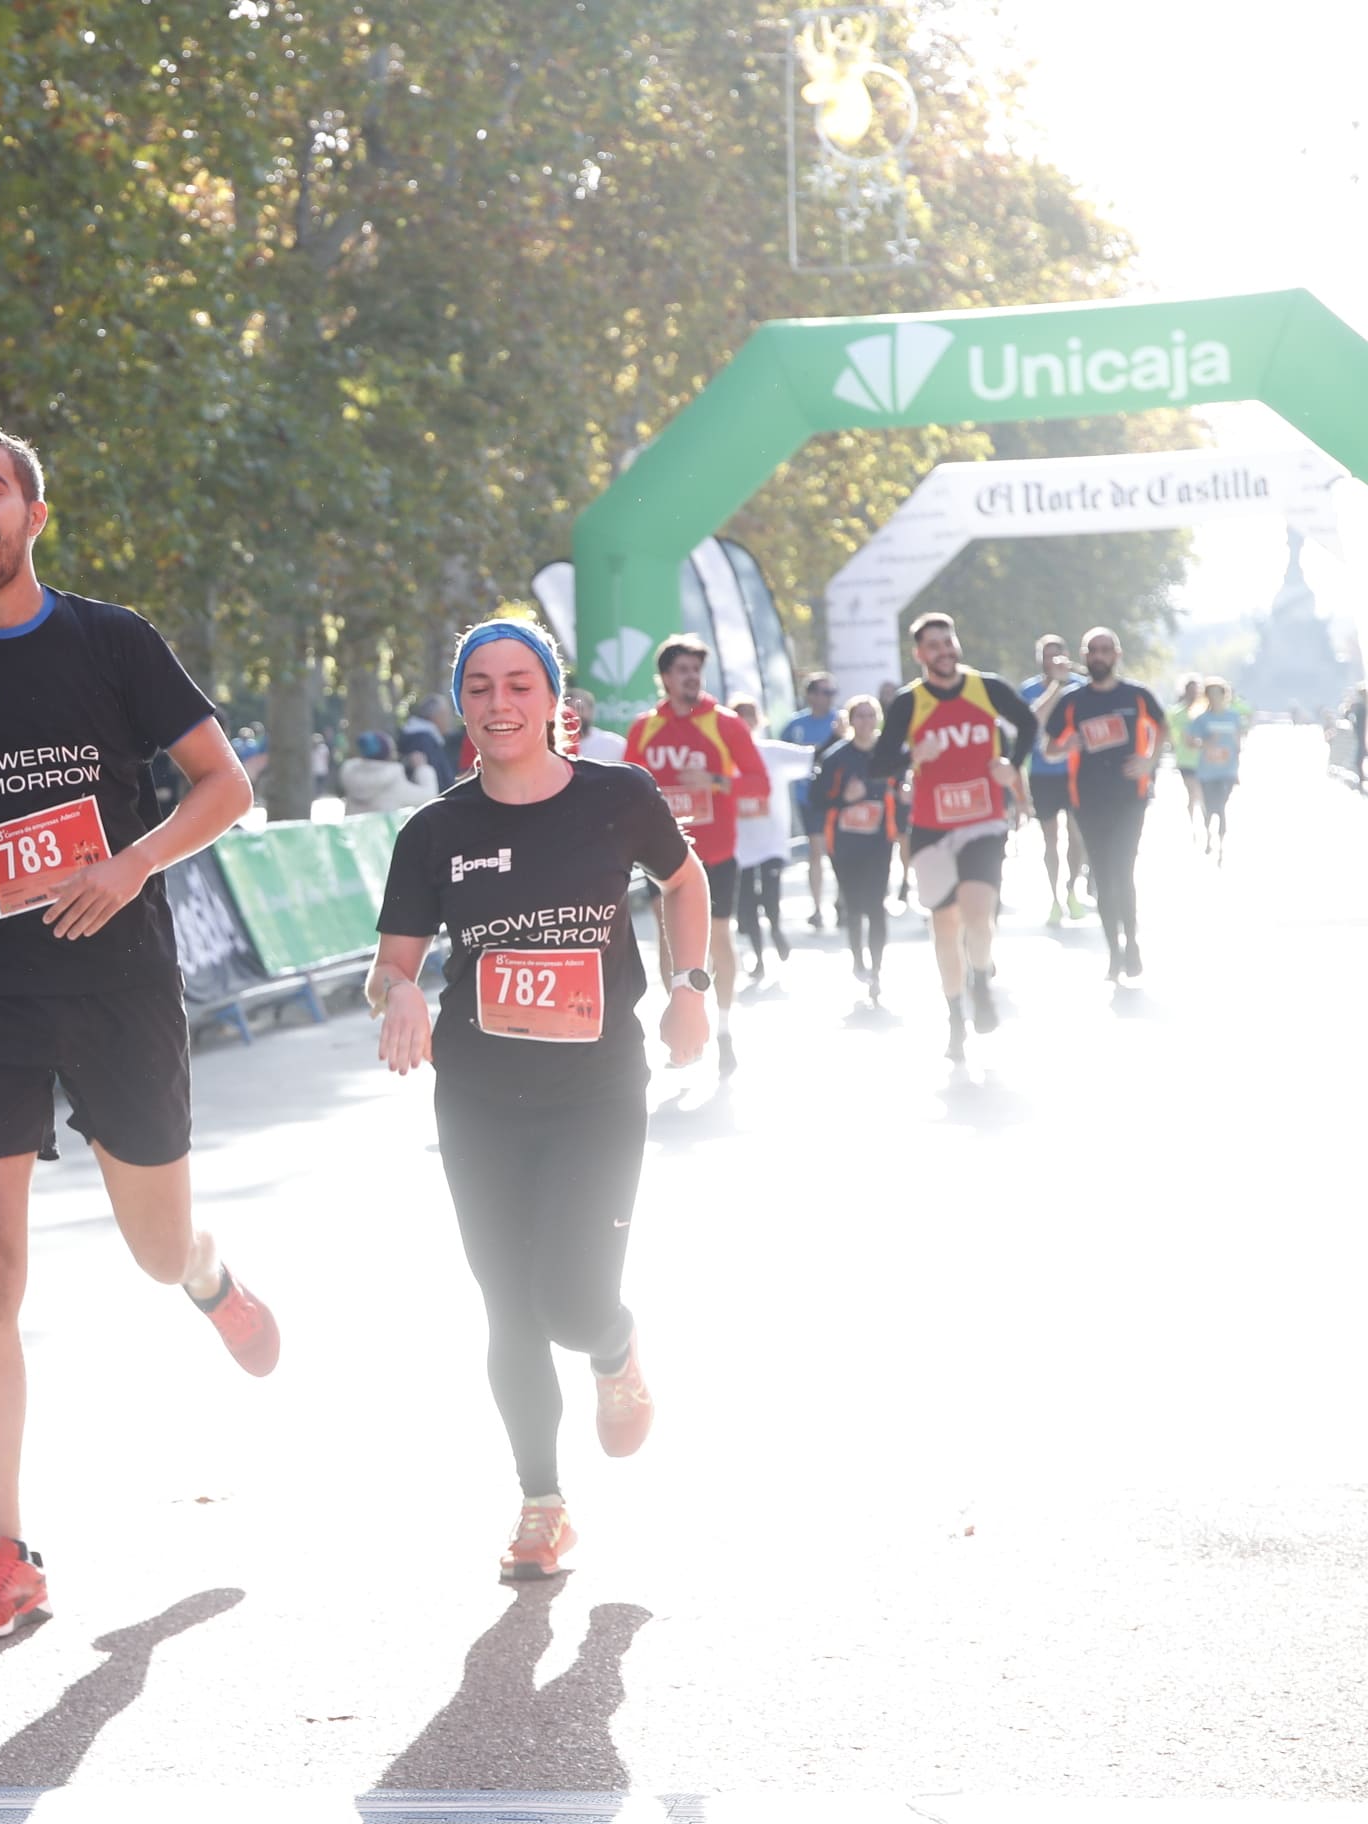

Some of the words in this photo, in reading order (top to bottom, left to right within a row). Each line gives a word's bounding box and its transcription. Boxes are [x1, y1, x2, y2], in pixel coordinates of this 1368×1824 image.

[968, 329, 1231, 401] Unicaja
[976, 482, 1013, 516] El
[1023, 480, 1101, 514] Norte
[1111, 480, 1139, 509] de
[1147, 467, 1270, 507] Castilla
[645, 745, 707, 771] UVa
[451, 848, 512, 883] HORSE
[461, 904, 617, 947] #POWERING
[495, 967, 556, 1007] 782
